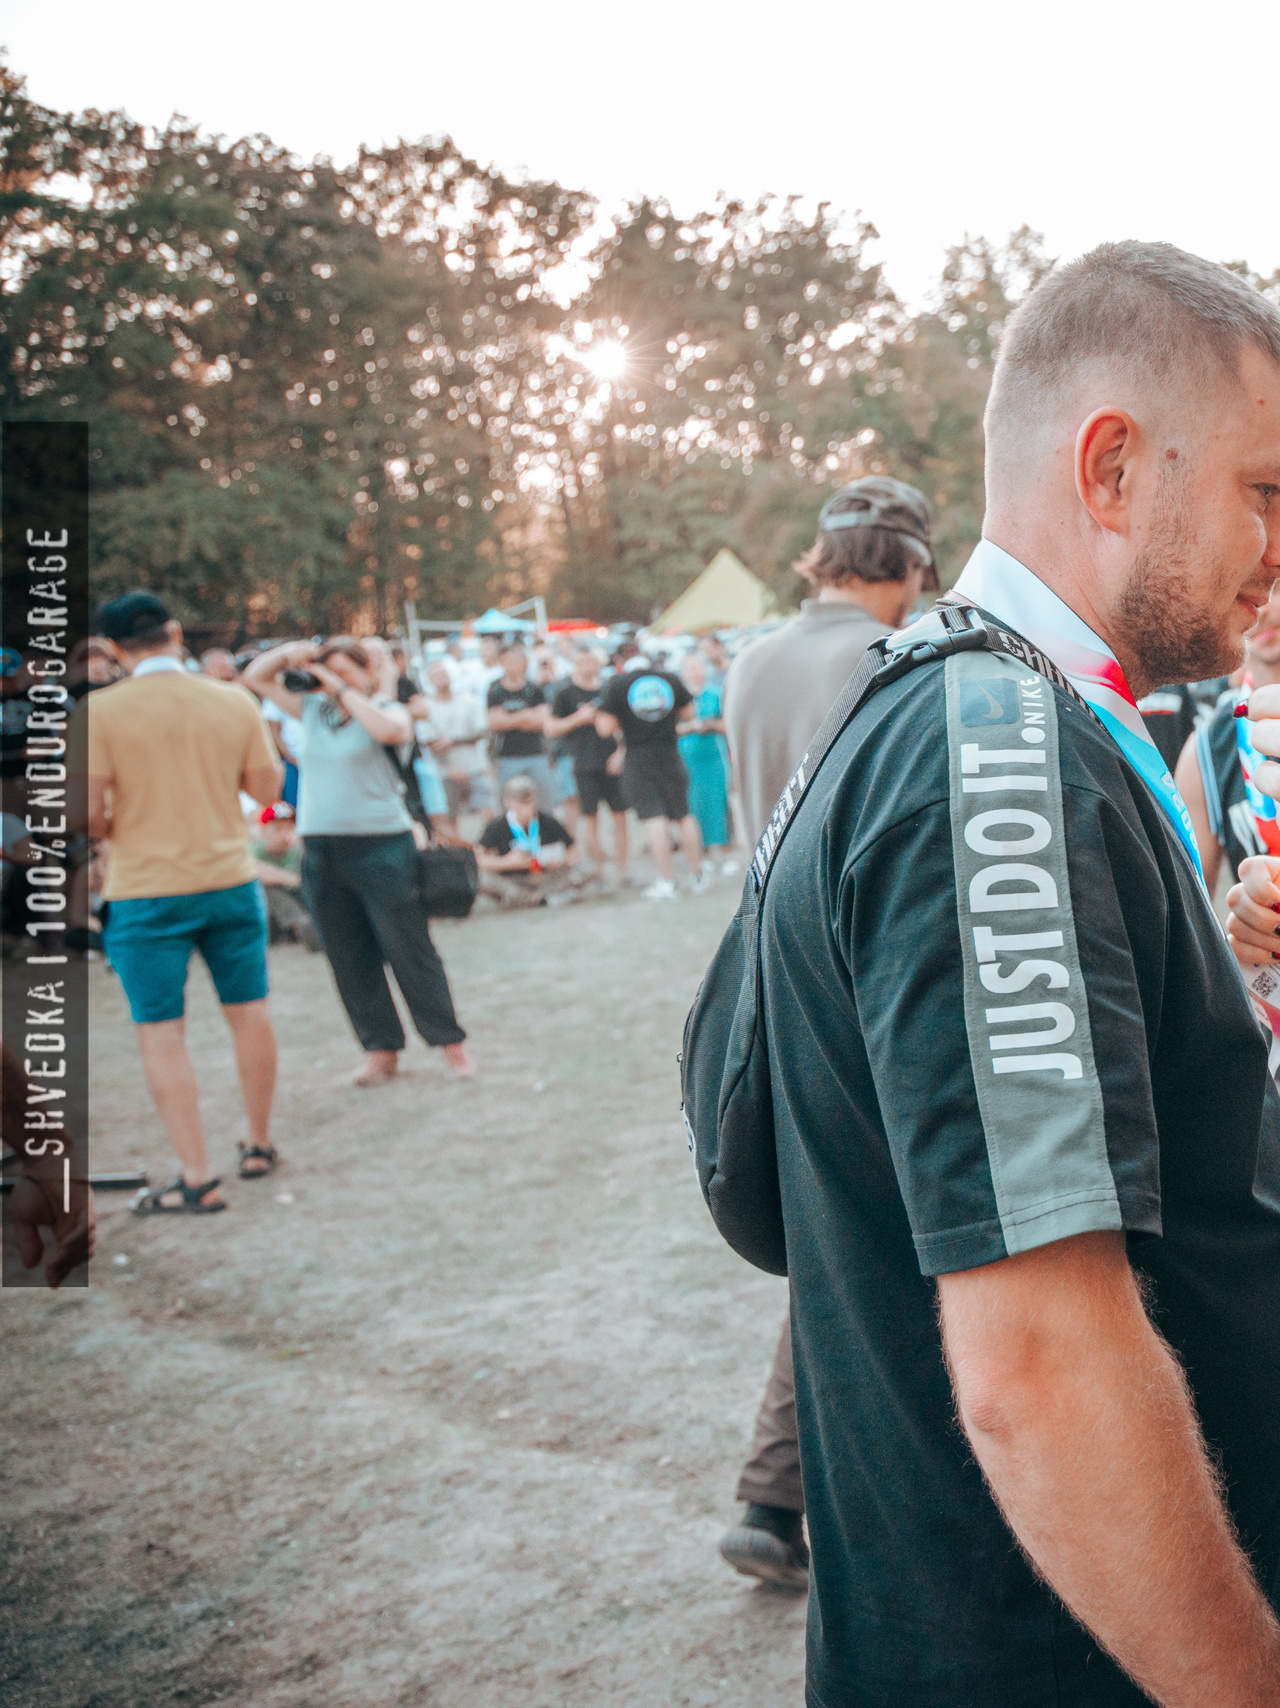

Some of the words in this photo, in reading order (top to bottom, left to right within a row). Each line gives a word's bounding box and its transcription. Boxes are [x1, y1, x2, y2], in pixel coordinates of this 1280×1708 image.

[1020, 676, 1046, 725] NIKE
[964, 808, 1060, 913] DO
[973, 925, 1084, 1080] JUST
